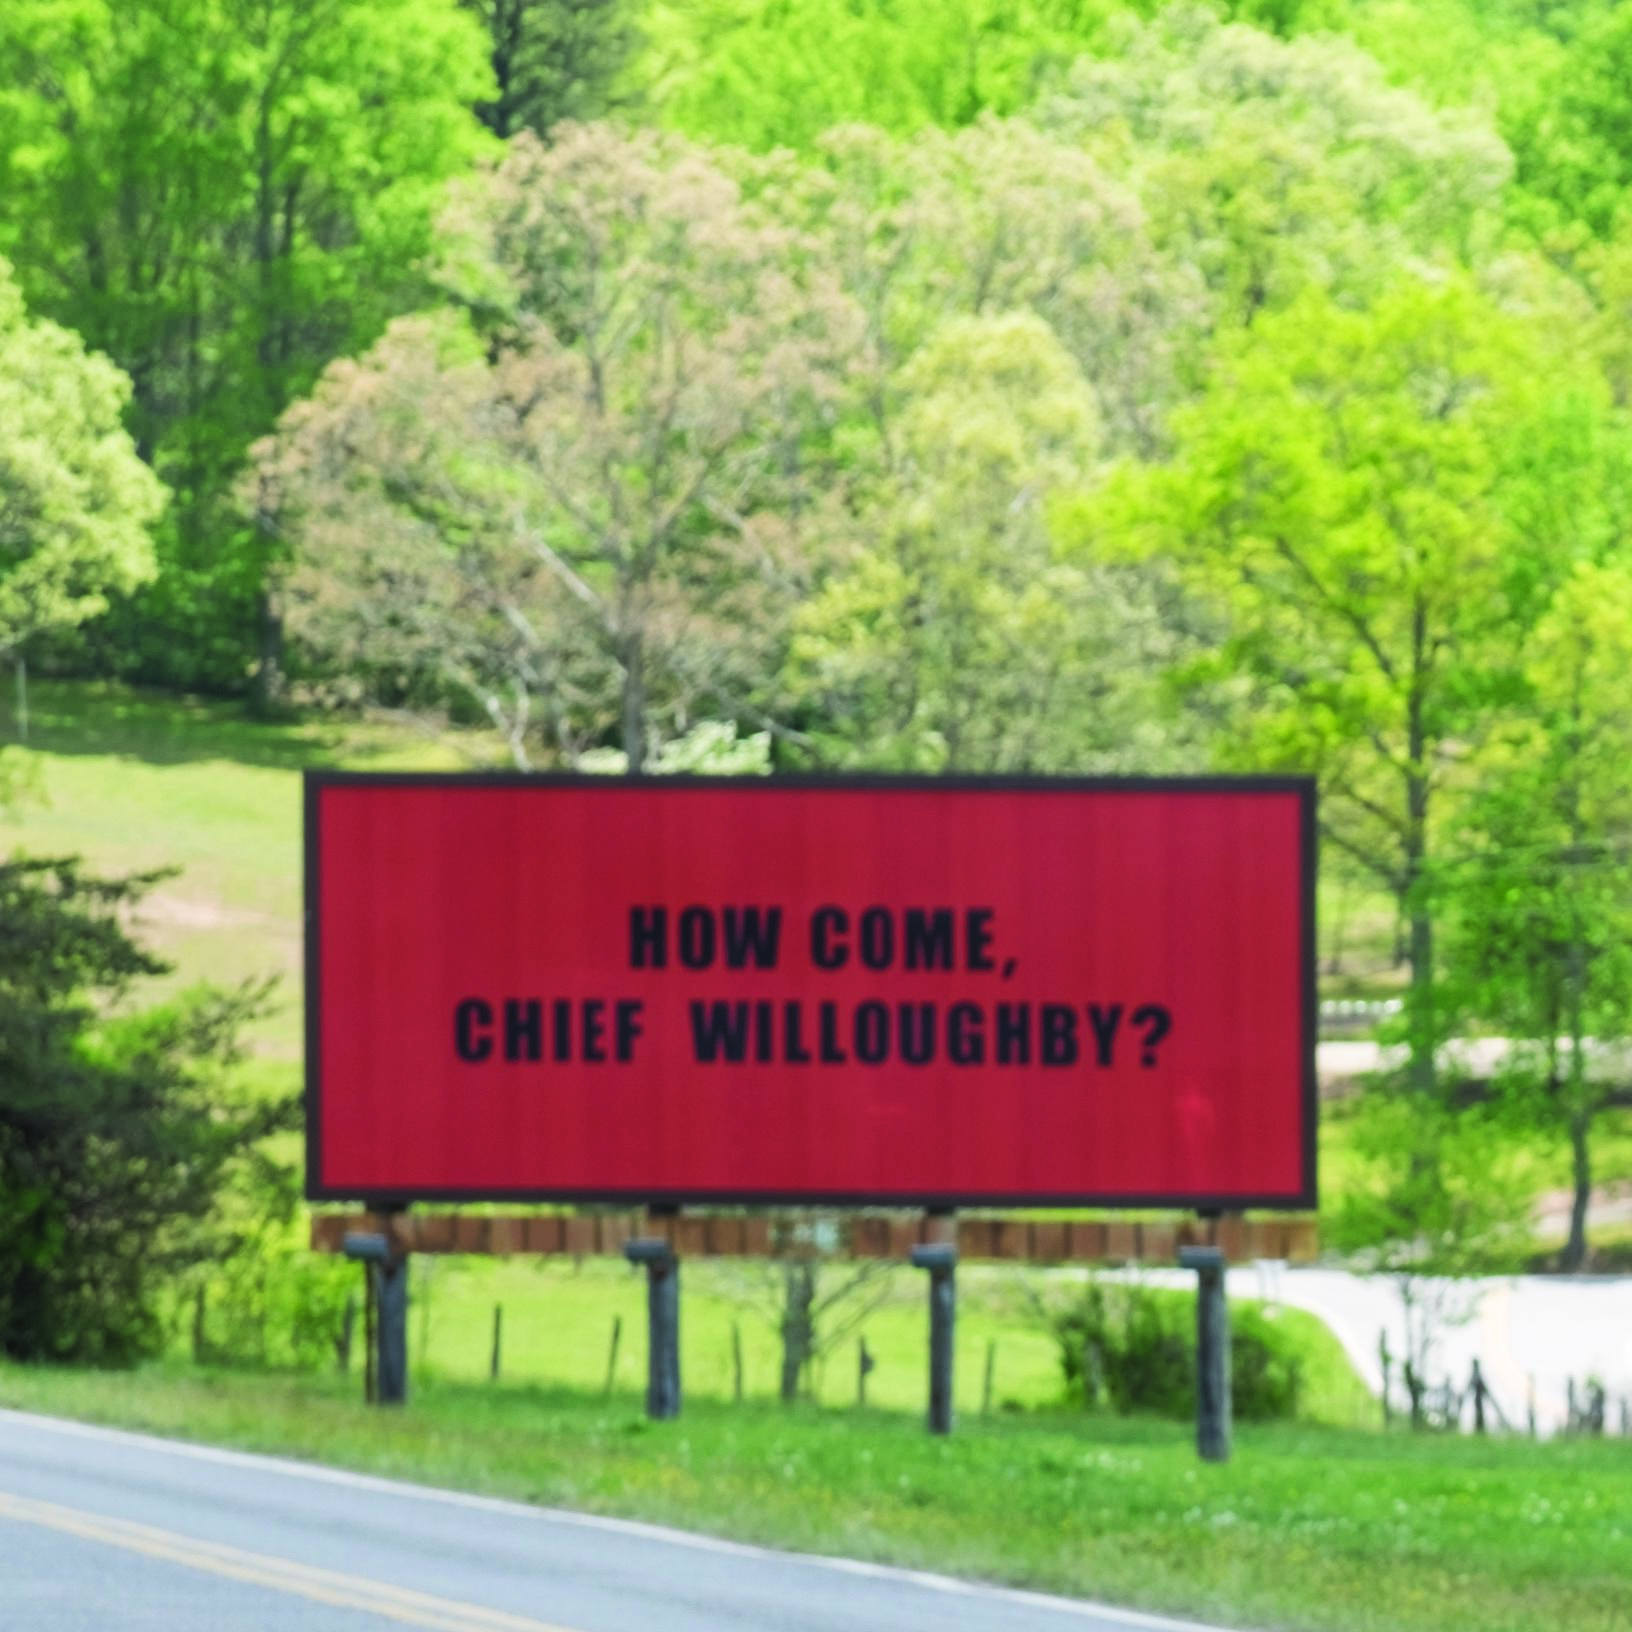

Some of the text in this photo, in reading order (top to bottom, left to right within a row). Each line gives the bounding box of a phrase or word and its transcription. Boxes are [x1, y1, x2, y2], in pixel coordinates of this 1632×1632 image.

[628, 904, 1018, 979] HOW COME,
[453, 997, 1173, 1069] CHIEF WILLOUGHBY?
